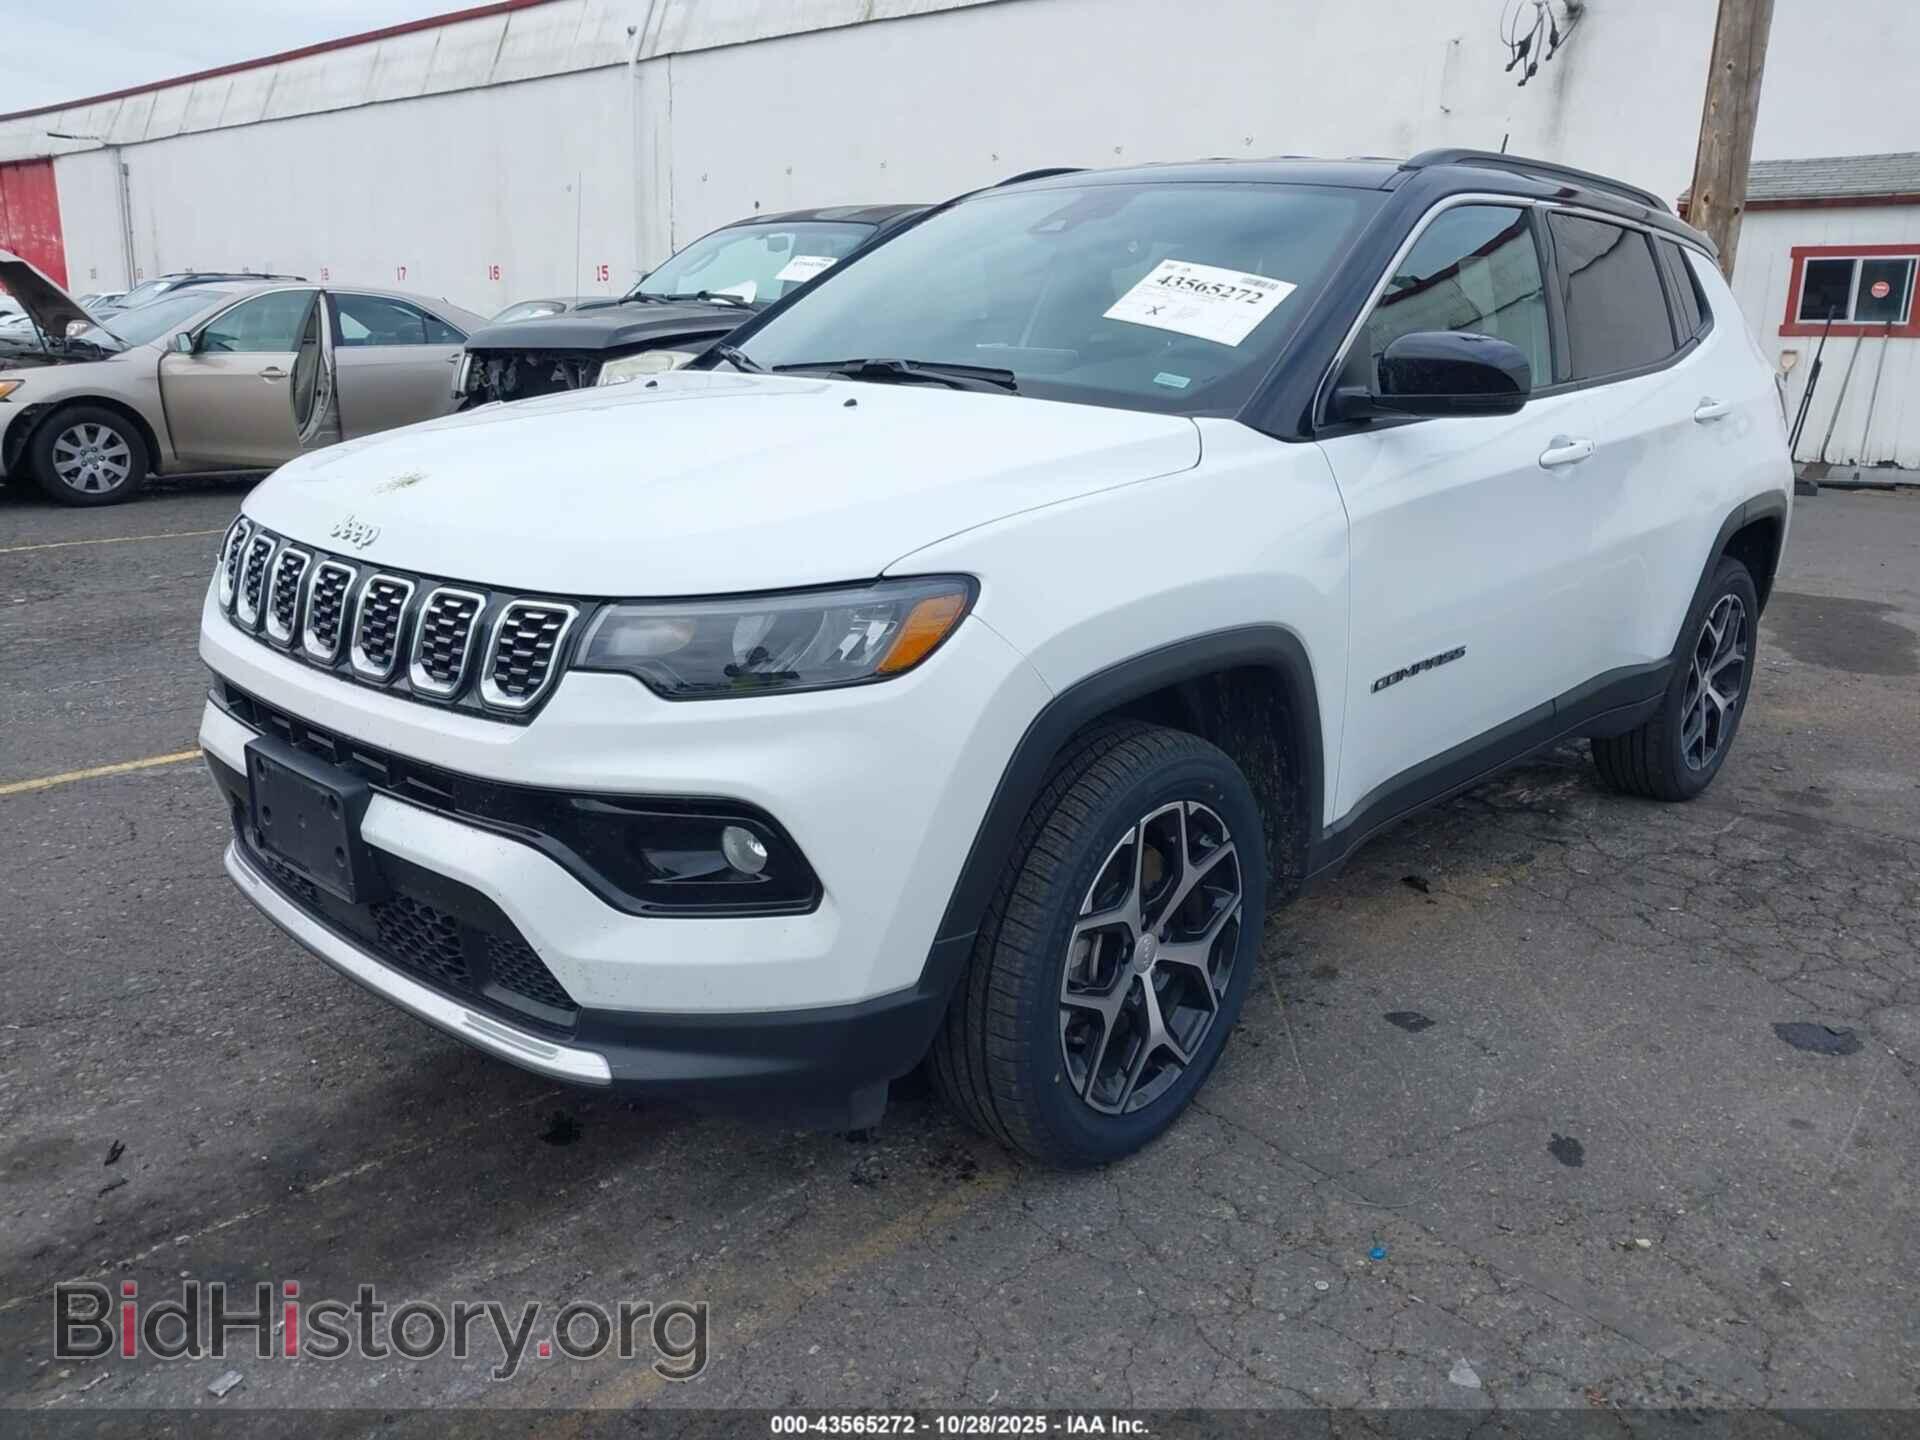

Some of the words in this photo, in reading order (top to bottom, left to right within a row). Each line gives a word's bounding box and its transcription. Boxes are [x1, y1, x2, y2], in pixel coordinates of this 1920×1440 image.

[396, 265, 407, 281] 17
[488, 264, 501, 281] 16
[596, 264, 609, 282] 15
[1156, 274, 1265, 305] 43565272
[330, 513, 382, 551] Jeep
[1370, 645, 1467, 694] COMPASS
